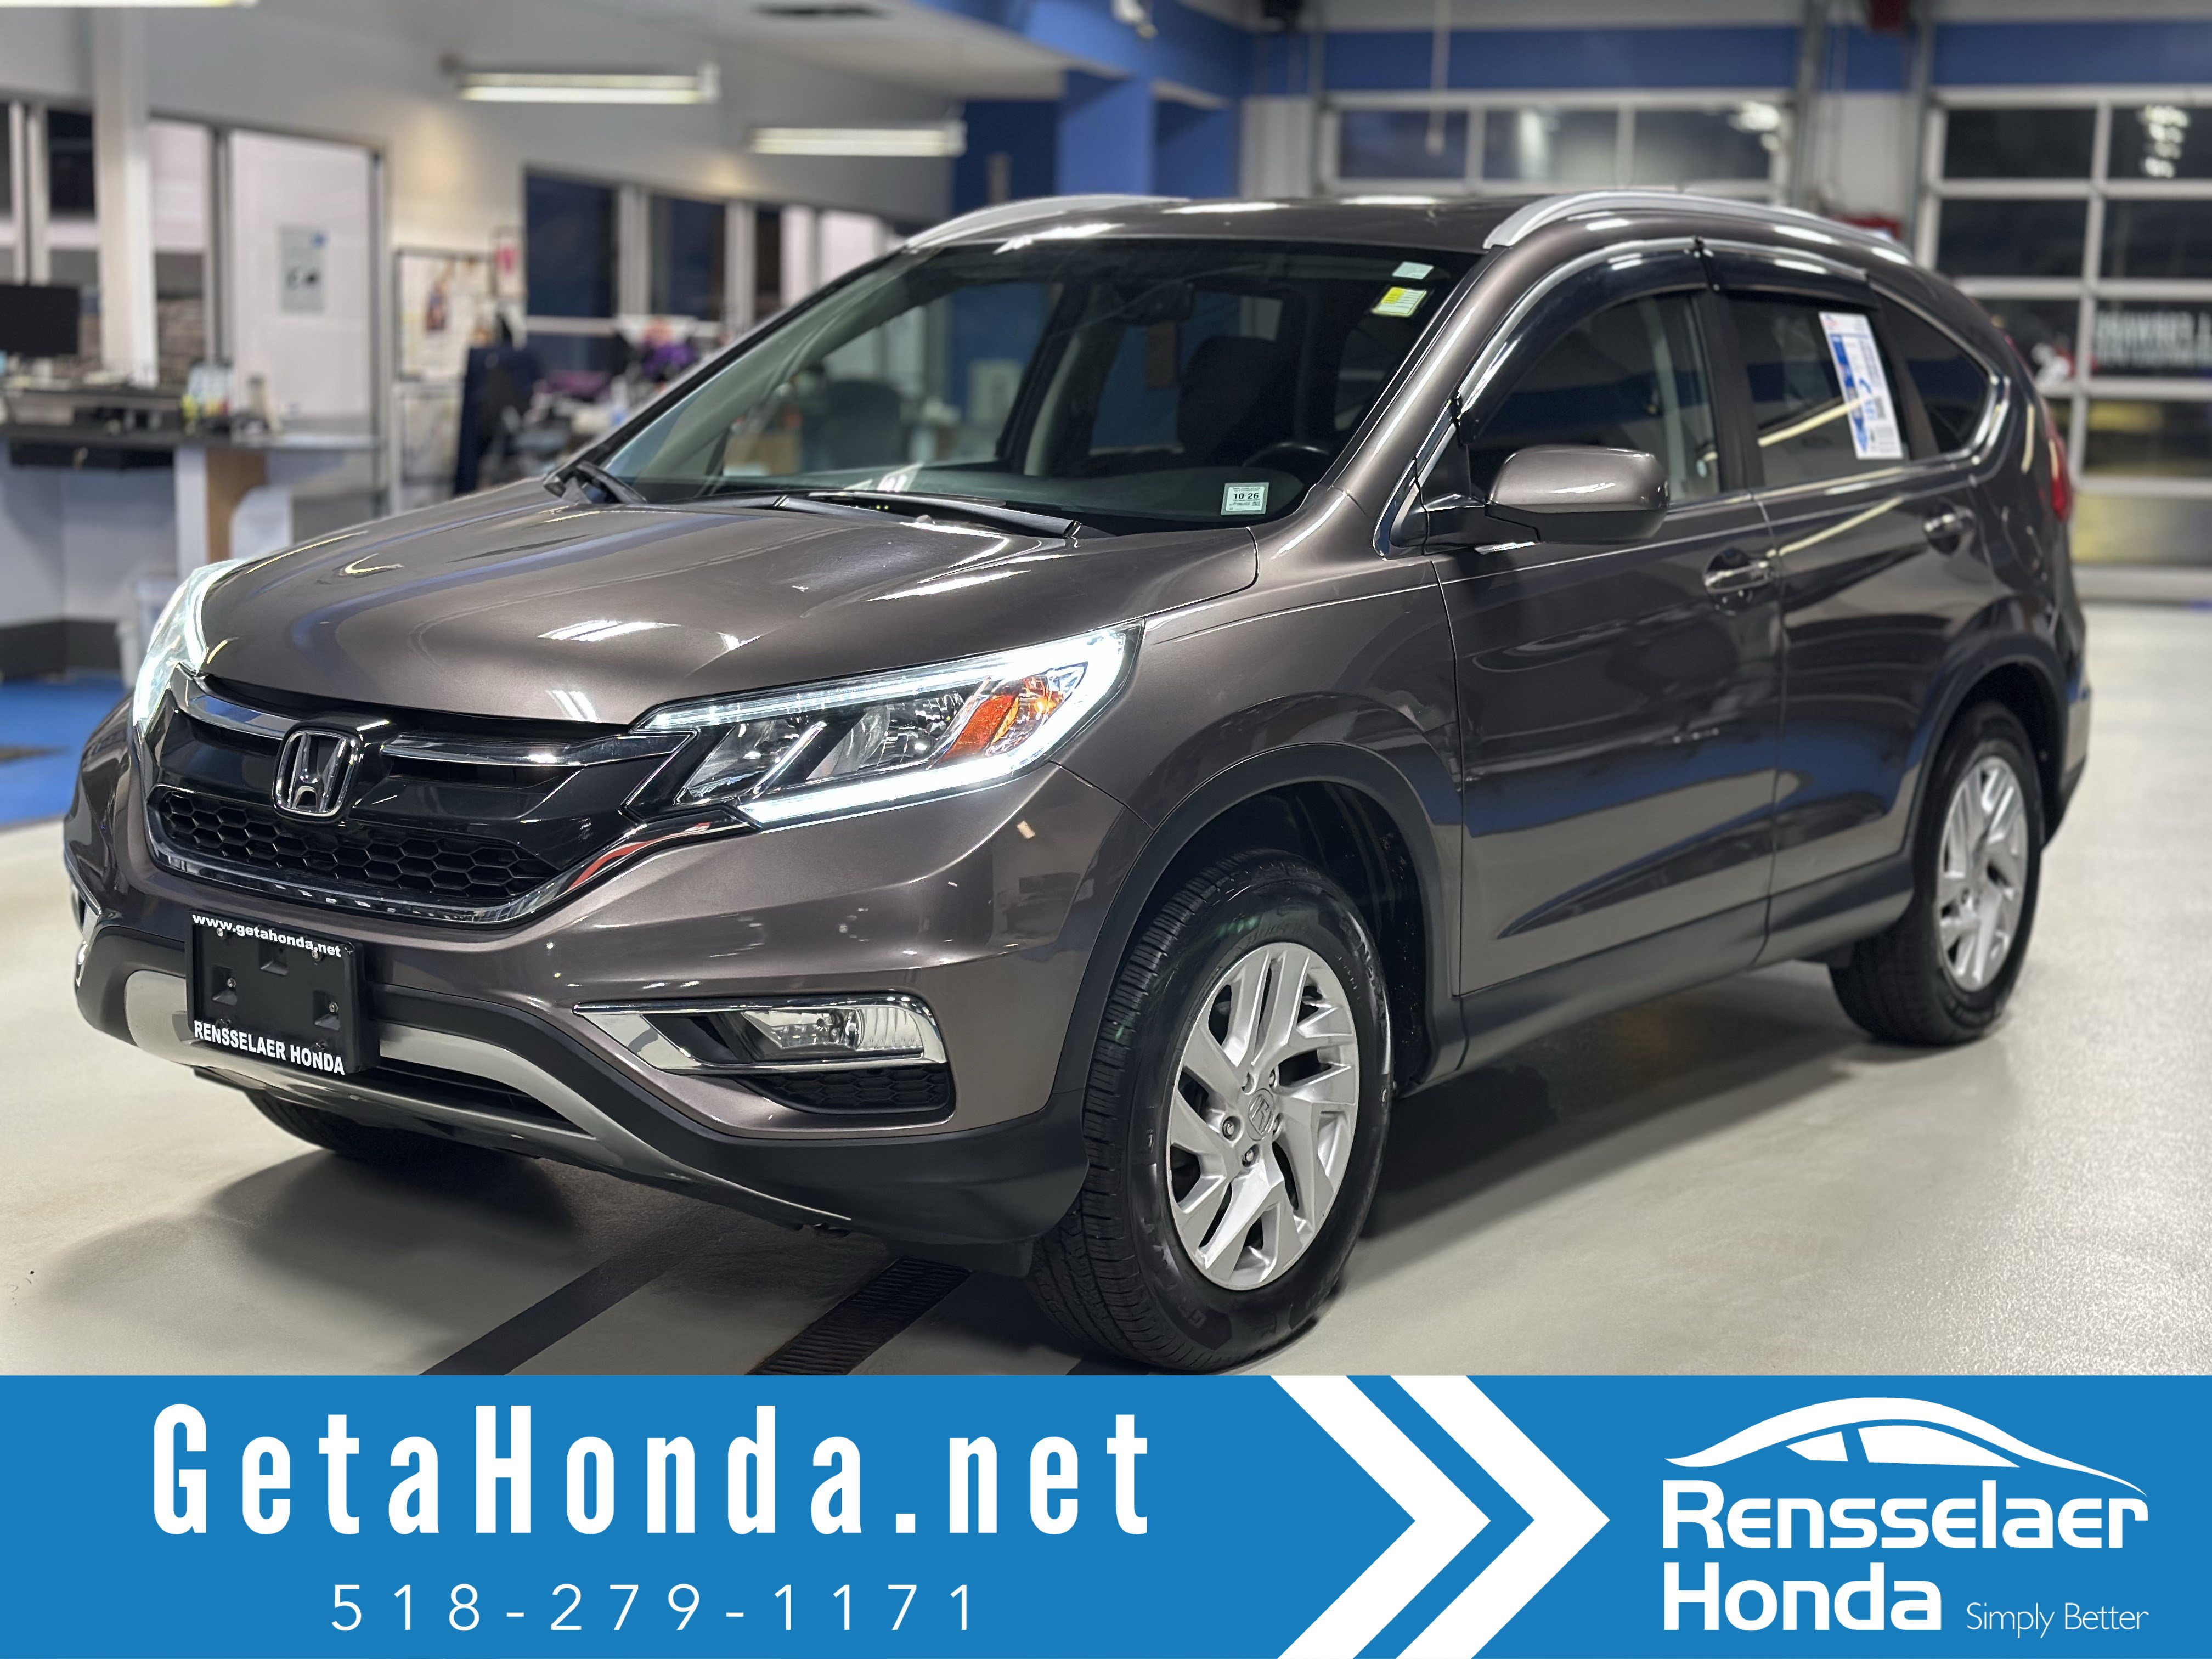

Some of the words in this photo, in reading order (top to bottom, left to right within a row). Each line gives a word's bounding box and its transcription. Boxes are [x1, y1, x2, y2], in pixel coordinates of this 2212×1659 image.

[192, 914, 341, 957] www.getahonda.net
[194, 1020, 286, 1061] RENSSELAER
[290, 1044, 346, 1075] HONDA
